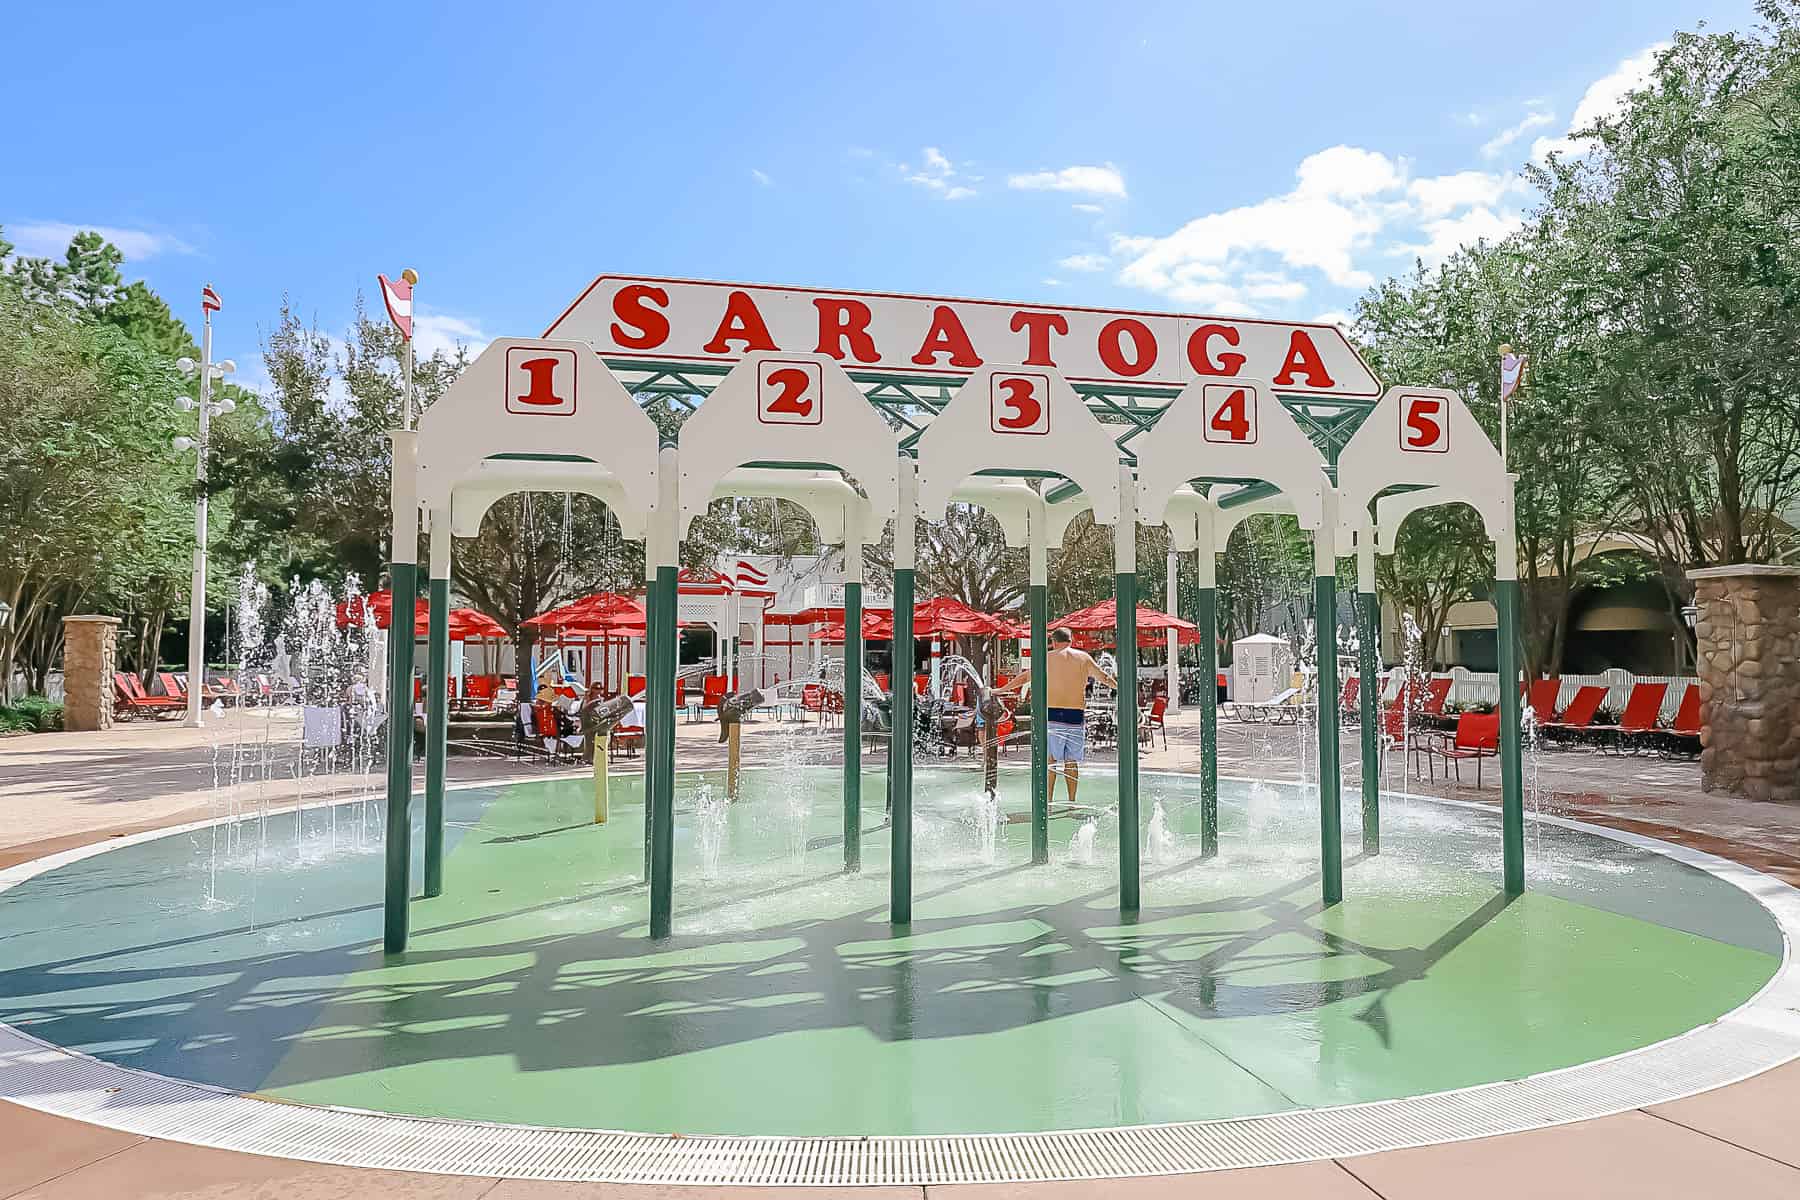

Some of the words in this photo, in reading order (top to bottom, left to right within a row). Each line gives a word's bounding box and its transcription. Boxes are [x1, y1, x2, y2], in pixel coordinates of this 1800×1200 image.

[610, 284, 1336, 388] SARATOGA
[518, 359, 564, 405] 1
[767, 369, 813, 417] 2
[999, 379, 1042, 428] 3
[1212, 390, 1250, 441] 4
[1406, 399, 1441, 447] 5
